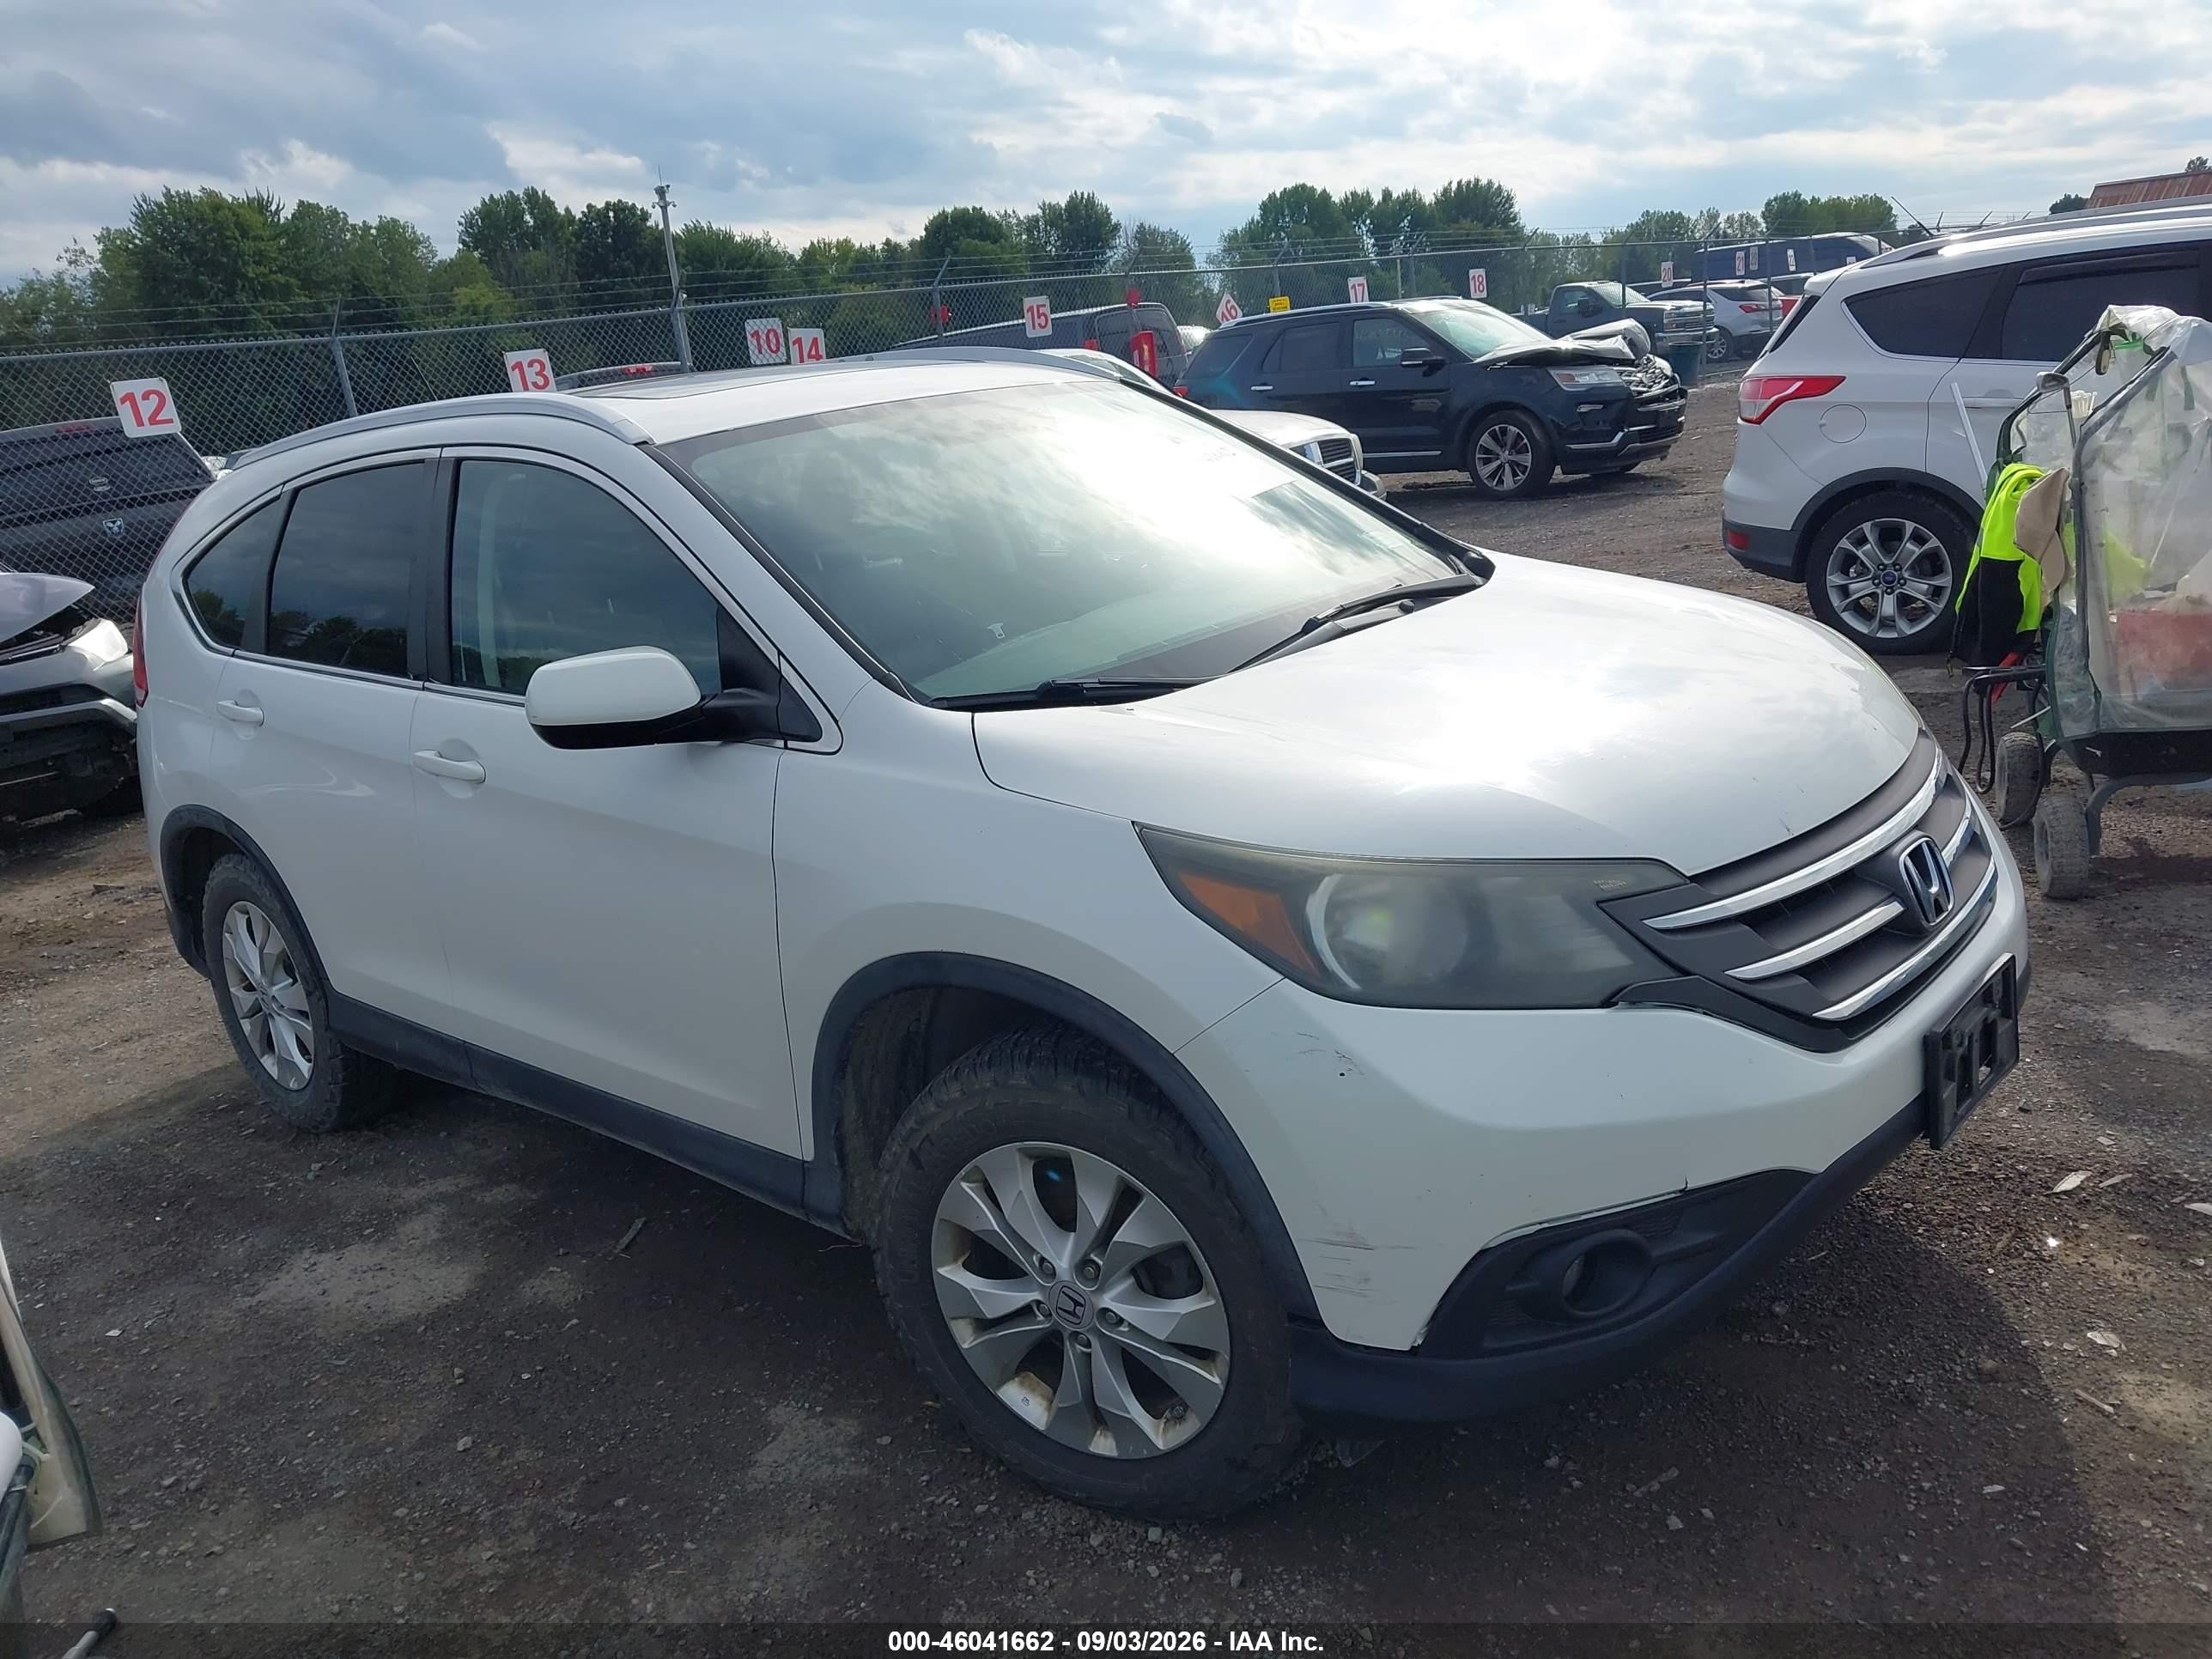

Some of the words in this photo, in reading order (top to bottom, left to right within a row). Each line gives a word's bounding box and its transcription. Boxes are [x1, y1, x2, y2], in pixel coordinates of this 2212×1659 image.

[1662, 268, 1671, 282] 20
[1737, 256, 1744, 271] 21
[1352, 283, 1365, 302] 17
[1471, 275, 1485, 293] 18
[1026, 305, 1049, 330] 15
[751, 328, 781, 355] 10
[793, 337, 824, 363] 14
[511, 358, 550, 391] 13
[118, 389, 174, 428] 12
